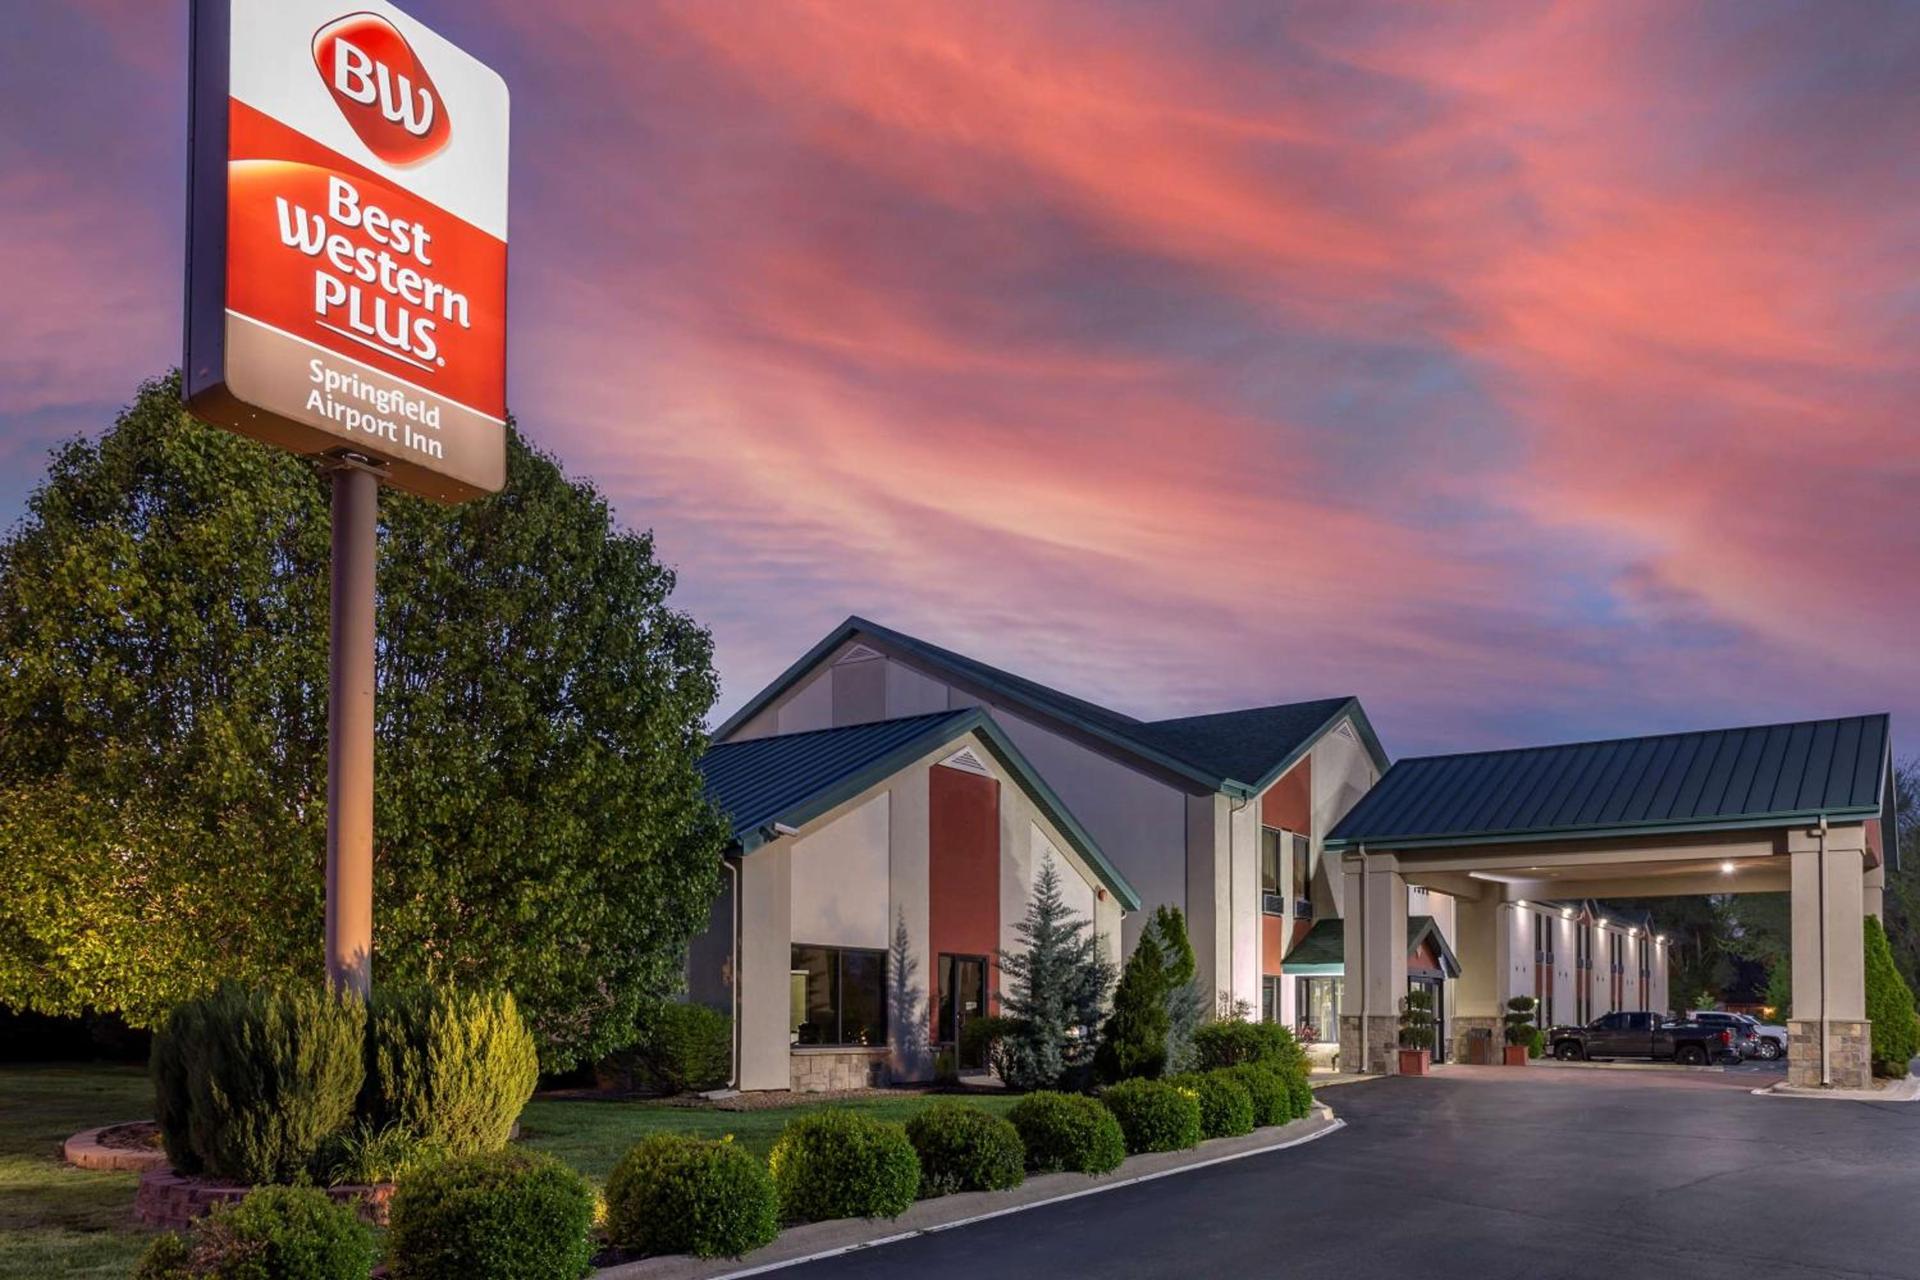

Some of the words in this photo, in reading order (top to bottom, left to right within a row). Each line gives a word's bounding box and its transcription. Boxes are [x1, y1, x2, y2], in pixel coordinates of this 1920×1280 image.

[335, 37, 433, 135] BW
[276, 196, 470, 328] Western
[329, 176, 431, 265] Best
[306, 390, 395, 443] Airport
[404, 424, 443, 459] Inn
[310, 359, 440, 429] Springfield
